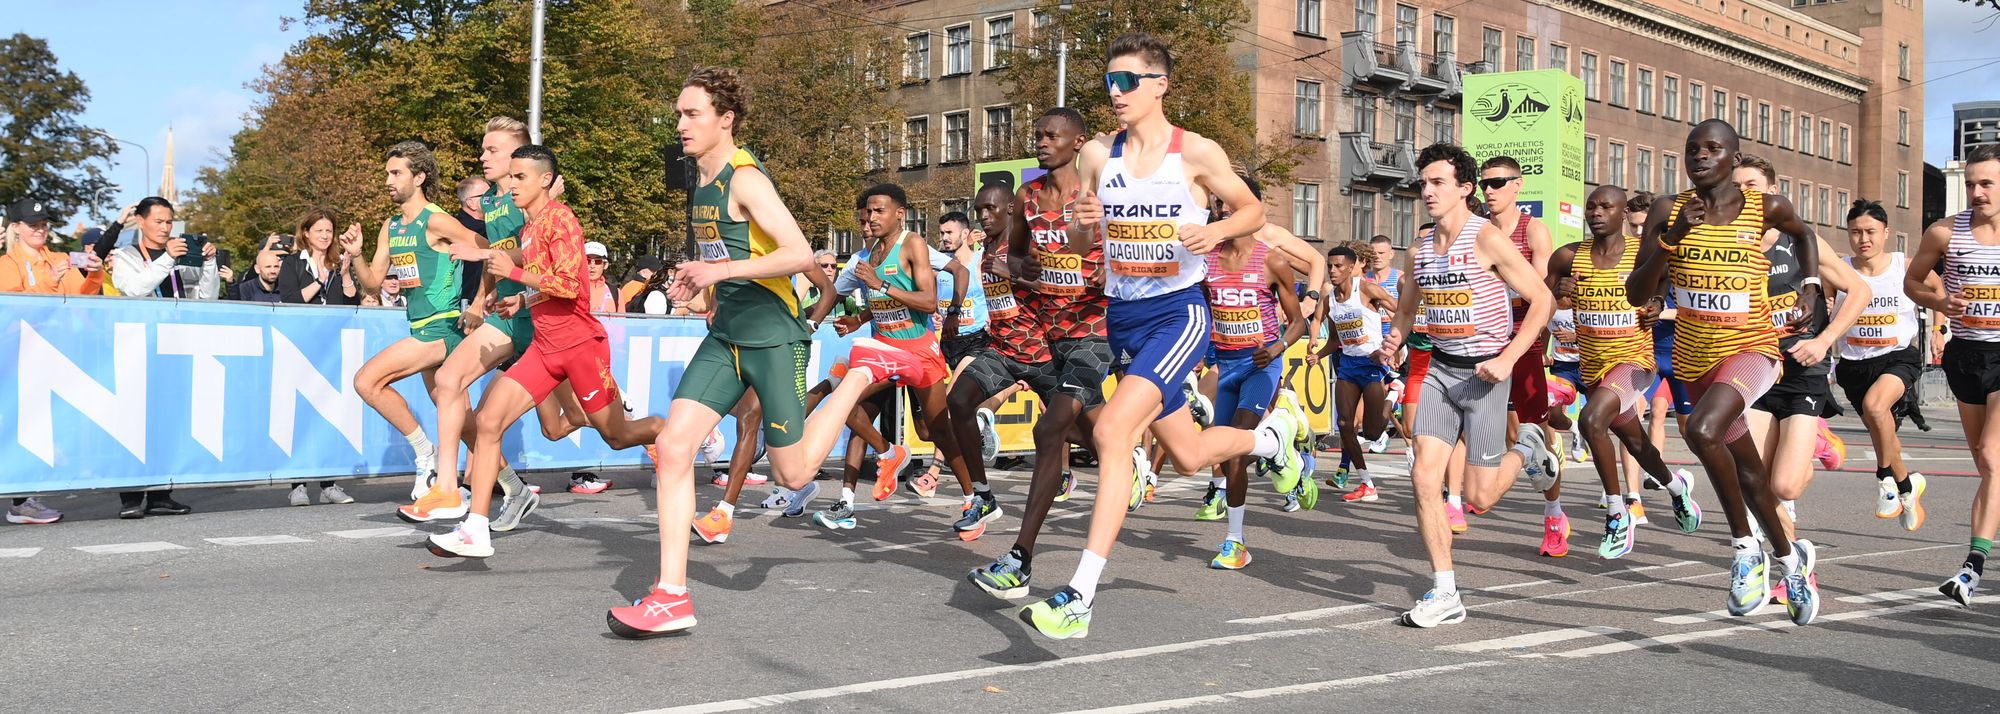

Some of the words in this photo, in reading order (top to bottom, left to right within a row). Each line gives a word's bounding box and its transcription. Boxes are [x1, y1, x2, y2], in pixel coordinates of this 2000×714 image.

[1504, 140, 1544, 148] ATHLETICS
[1502, 148, 1544, 156] RUNNING
[1521, 164, 1544, 175] 23
[1103, 204, 1182, 218] FRANCE
[1107, 223, 1174, 240] SEIKO
[1110, 243, 1174, 260] DAGUINOS
[1676, 247, 1750, 264] UGANDA
[1039, 254, 1078, 270] EIKO
[1154, 266, 1168, 274] 23
[1958, 264, 2000, 276] CANA
[1040, 269, 1078, 285] EMBOI
[1419, 272, 1468, 286] CANADA
[1676, 272, 1748, 290] SEIKO
[1209, 288, 1258, 306] USA
[1576, 288, 1628, 297] UGAND
[1962, 288, 2000, 300] SEI
[1426, 292, 1470, 306] EIKO
[1688, 292, 1731, 310] YEKO
[1578, 300, 1632, 312] SEIKO
[1213, 310, 1258, 321] SEIKO
[1334, 312, 1358, 322] ISRAEL
[1580, 312, 1632, 326] CHEMUTAI
[1700, 314, 1722, 322] RIGA
[1857, 315, 1894, 325] EIKO
[1215, 322, 1260, 334] MUHUMED
[1859, 327, 1882, 337] GOH
[17, 318, 365, 468] NTN
